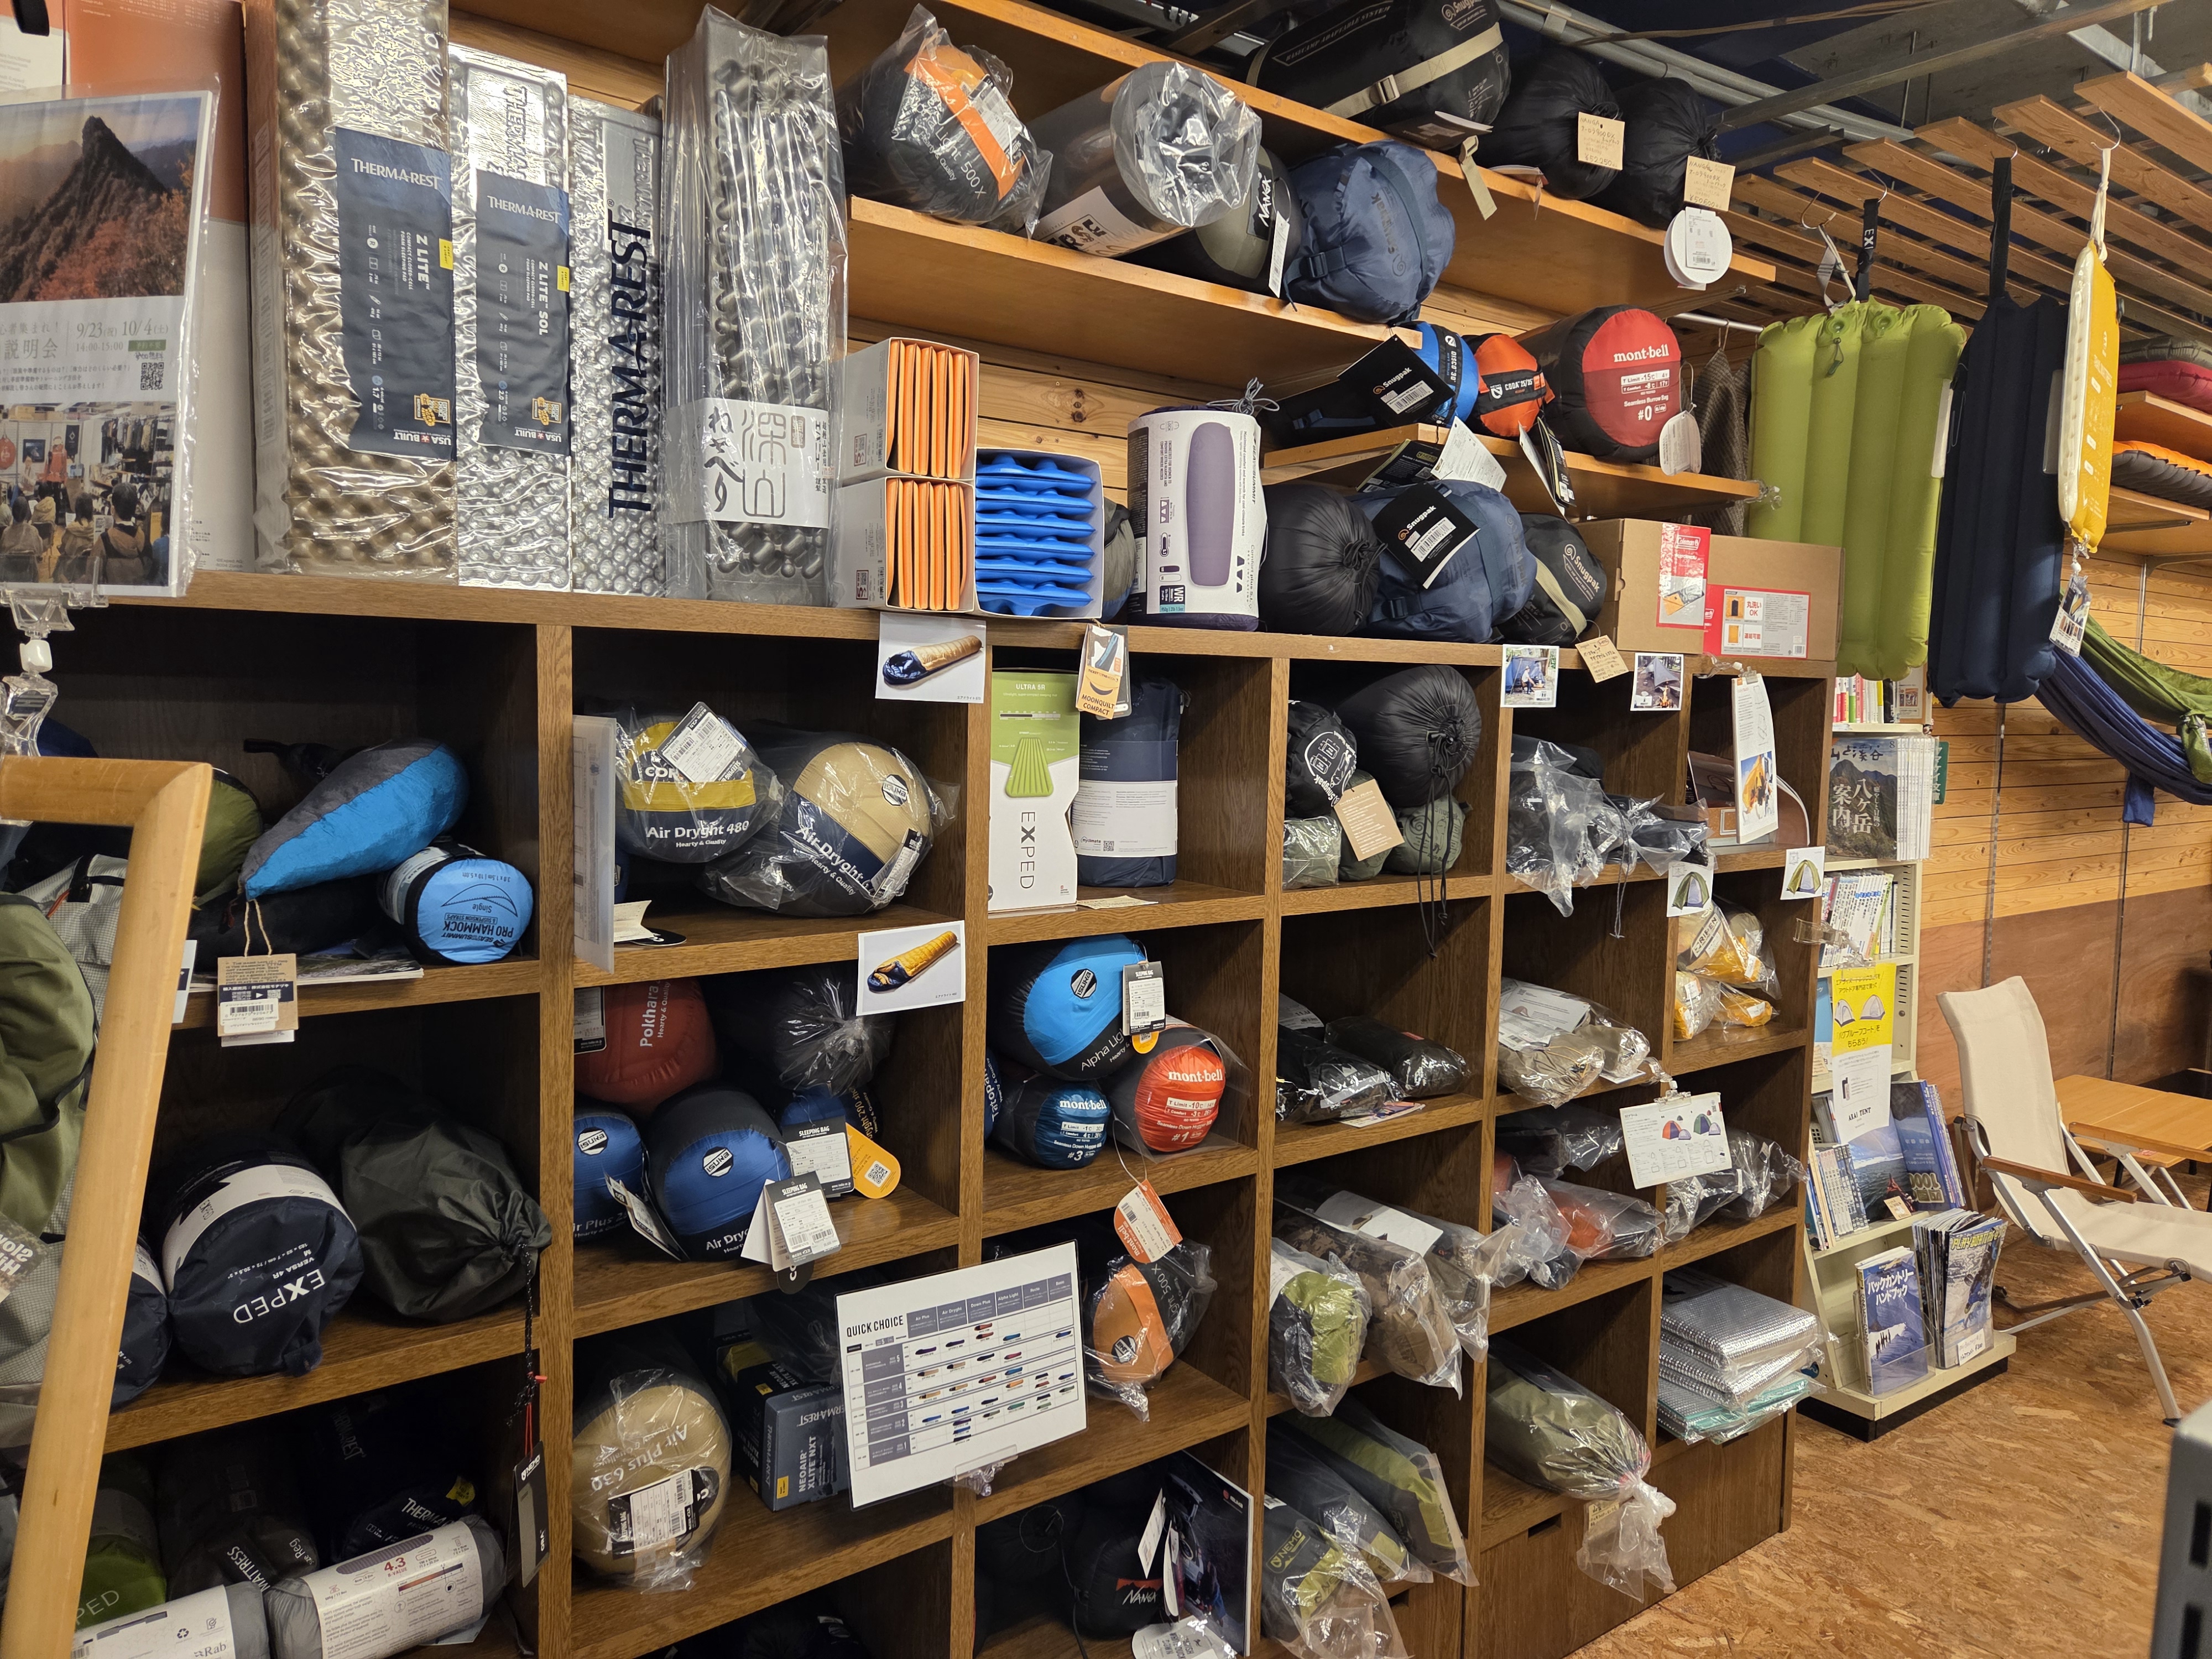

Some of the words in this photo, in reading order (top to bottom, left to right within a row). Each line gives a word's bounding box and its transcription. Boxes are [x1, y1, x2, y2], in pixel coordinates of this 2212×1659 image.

[935, 126, 962, 161] Light
[961, 161, 980, 187] 500
[940, 158, 957, 181] Quality
[1258, 178, 1272, 228] NANGA
[416, 233, 428, 246] Z
[539, 262, 548, 272] Z
[539, 310, 549, 335] SOL
[1383, 367, 1412, 388] Snugpak
[1624, 398, 1646, 408] Seamless
[1646, 395, 1661, 404] Burrow
[393, 431, 420, 442] BUILT
[432, 434, 451, 445] USA
[515, 429, 536, 439] BUILT
[545, 432, 562, 442] USA
[1406, 505, 1437, 530] Snugpak
[1573, 555, 1600, 593] Snugpak
[1173, 587, 1184, 602] WR
[1081, 693, 1115, 710] MOONQUILT
[1082, 702, 1110, 716] COMPACT
[1889, 740, 1896, 749] 8
[1314, 774, 1337, 802] Snugpak
[1832, 782, 1852, 828] 案内
[646, 826, 671, 839] Air
[726, 820, 750, 834] 480
[795, 827, 821, 847] Air
[1020, 811, 1036, 890] EXPED
[810, 854, 831, 874] Hearty
[835, 877, 857, 896] Quality
[472, 902, 492, 913] Single
[442, 920, 495, 936] HAMMOCK
[495, 926, 514, 938] PRO
[661, 981, 671, 1006] Quality
[639, 985, 659, 1047] Pokhara
[657, 1014, 667, 1038] Hearty
[1081, 1044, 1111, 1072] Alpha
[1109, 1046, 1126, 1063] Hearty
[1848, 1112, 1859, 1121] ARAI
[1859, 1107, 1872, 1117] TENT
[798, 1128, 818, 1137] SLEEPING
[818, 1125, 831, 1134] BAG
[1156, 1120, 1178, 1129] Seamless
[581, 1133, 606, 1151] ISUKA
[1053, 1140, 1072, 1149] Seamless
[1171, 1131, 1190, 1143] #1
[705, 1151, 732, 1172] ISUKA
[1067, 1150, 1084, 1162] #3
[782, 1186, 799, 1196] SLEEPING
[798, 1182, 808, 1192] BAG
[586, 1217, 612, 1230] Plus
[303, 1249, 312, 1257] M
[706, 1238, 722, 1251] Air
[285, 1257, 315, 1273] VERSA
[272, 1270, 285, 1280] 4R
[1867, 1268, 1914, 1295] バックカントリー
[233, 1269, 326, 1324] EXPED
[1009, 1291, 1019, 1300] Light
[1875, 1284, 1908, 1306] ハンドブック
[846, 1321, 873, 1339] QUICK
[873, 1314, 904, 1331] CHOICE
[895, 1354, 901, 1363] 5
[898, 1381, 903, 1390] 4
[899, 1400, 904, 1408] 3
[901, 1418, 906, 1427] 2
[664, 1423, 688, 1450] Air
[526, 1454, 541, 1473] NEMO
[628, 1443, 663, 1473] Plus
[591, 1467, 625, 1492] 630
[289, 1537, 306, 1559] Reg
[1279, 1527, 1304, 1561] NEMO
[227, 1545, 270, 1593] MATTRESS
[383, 1557, 407, 1574] 4.3
[387, 1566, 408, 1578] R-VALUE
[1122, 1589, 1157, 1606] NANGA
[205, 1641, 227, 1658] Rab
